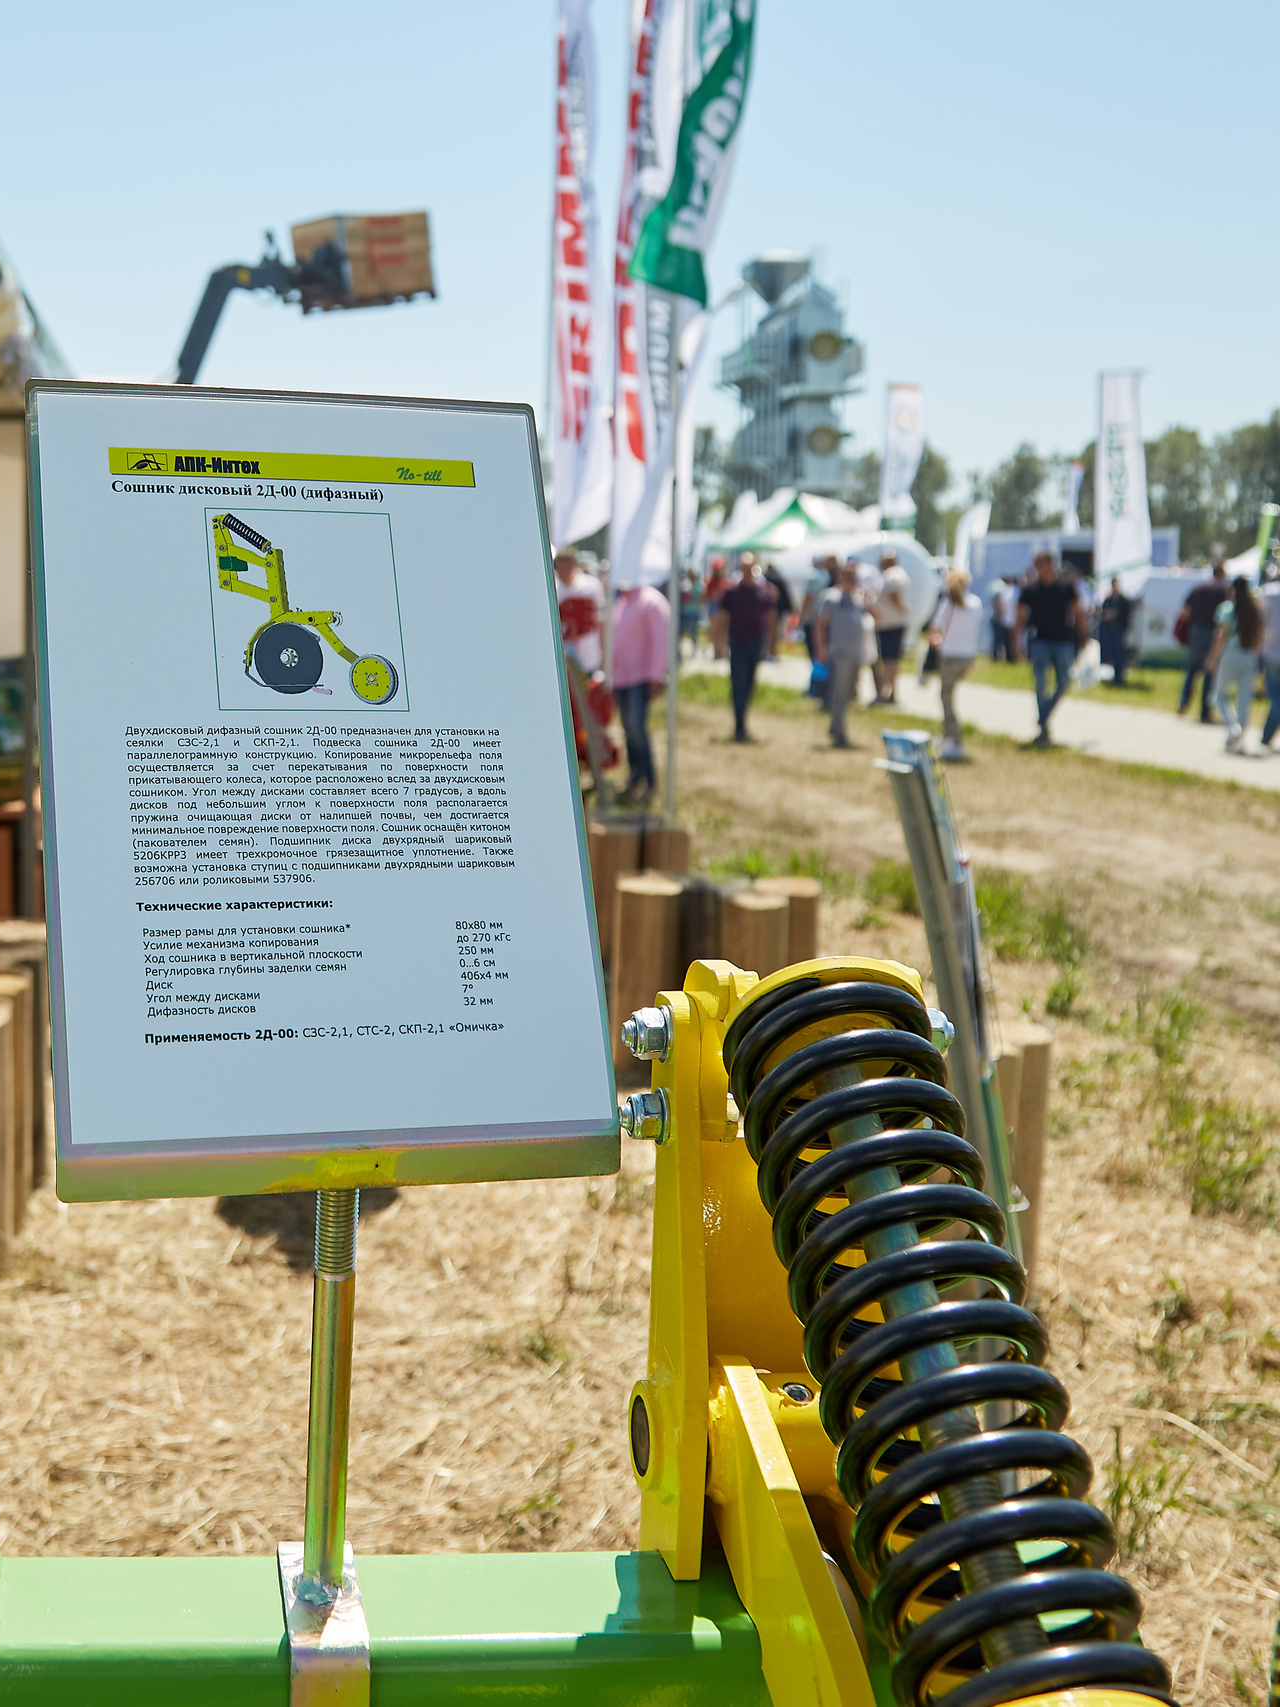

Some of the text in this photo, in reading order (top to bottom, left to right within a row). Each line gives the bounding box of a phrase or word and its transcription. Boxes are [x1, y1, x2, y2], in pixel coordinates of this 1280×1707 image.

[174, 455, 261, 475] АПК-Интех
[396, 466, 442, 481] No-till
[110, 479, 384, 504] Сошник дисковый 2Д-00 (дифазный)
[125, 737, 502, 749] сеялки СЗС-2,1 и СКП-2,1. Подвеска сошника 2Д-00 имеет
[130, 810, 510, 825] пружина очищающая диски от налипшей почвы, чем достигается
[134, 899, 333, 912] Технические характеристики:
[488, 921, 503, 930] мм
[142, 927, 182, 939] Размер
[184, 927, 214, 939] рамы
[216, 927, 237, 937] для
[239, 926, 296, 937] установки
[455, 932, 512, 944] до 270 кГс
[142, 938, 319, 951] Усилие механизма копирования
[457, 945, 494, 956] 250 мм
[143, 949, 363, 965] Ход сошника в вертикальной плоскости
[482, 959, 496, 968] см
[144, 963, 347, 979] Регулировка глубины заделки семян
[494, 971, 509, 980] мм
[145, 979, 174, 992] Диск
[145, 991, 261, 1004] Угол между дисками
[462, 995, 494, 1007] 32 мм
[146, 1004, 257, 1019] Дифазность дисков
[144, 1021, 505, 1046] Применяемость 2Д-00: СЗС-2,1, СТС-2, СКП-2,1 «Омичка»
